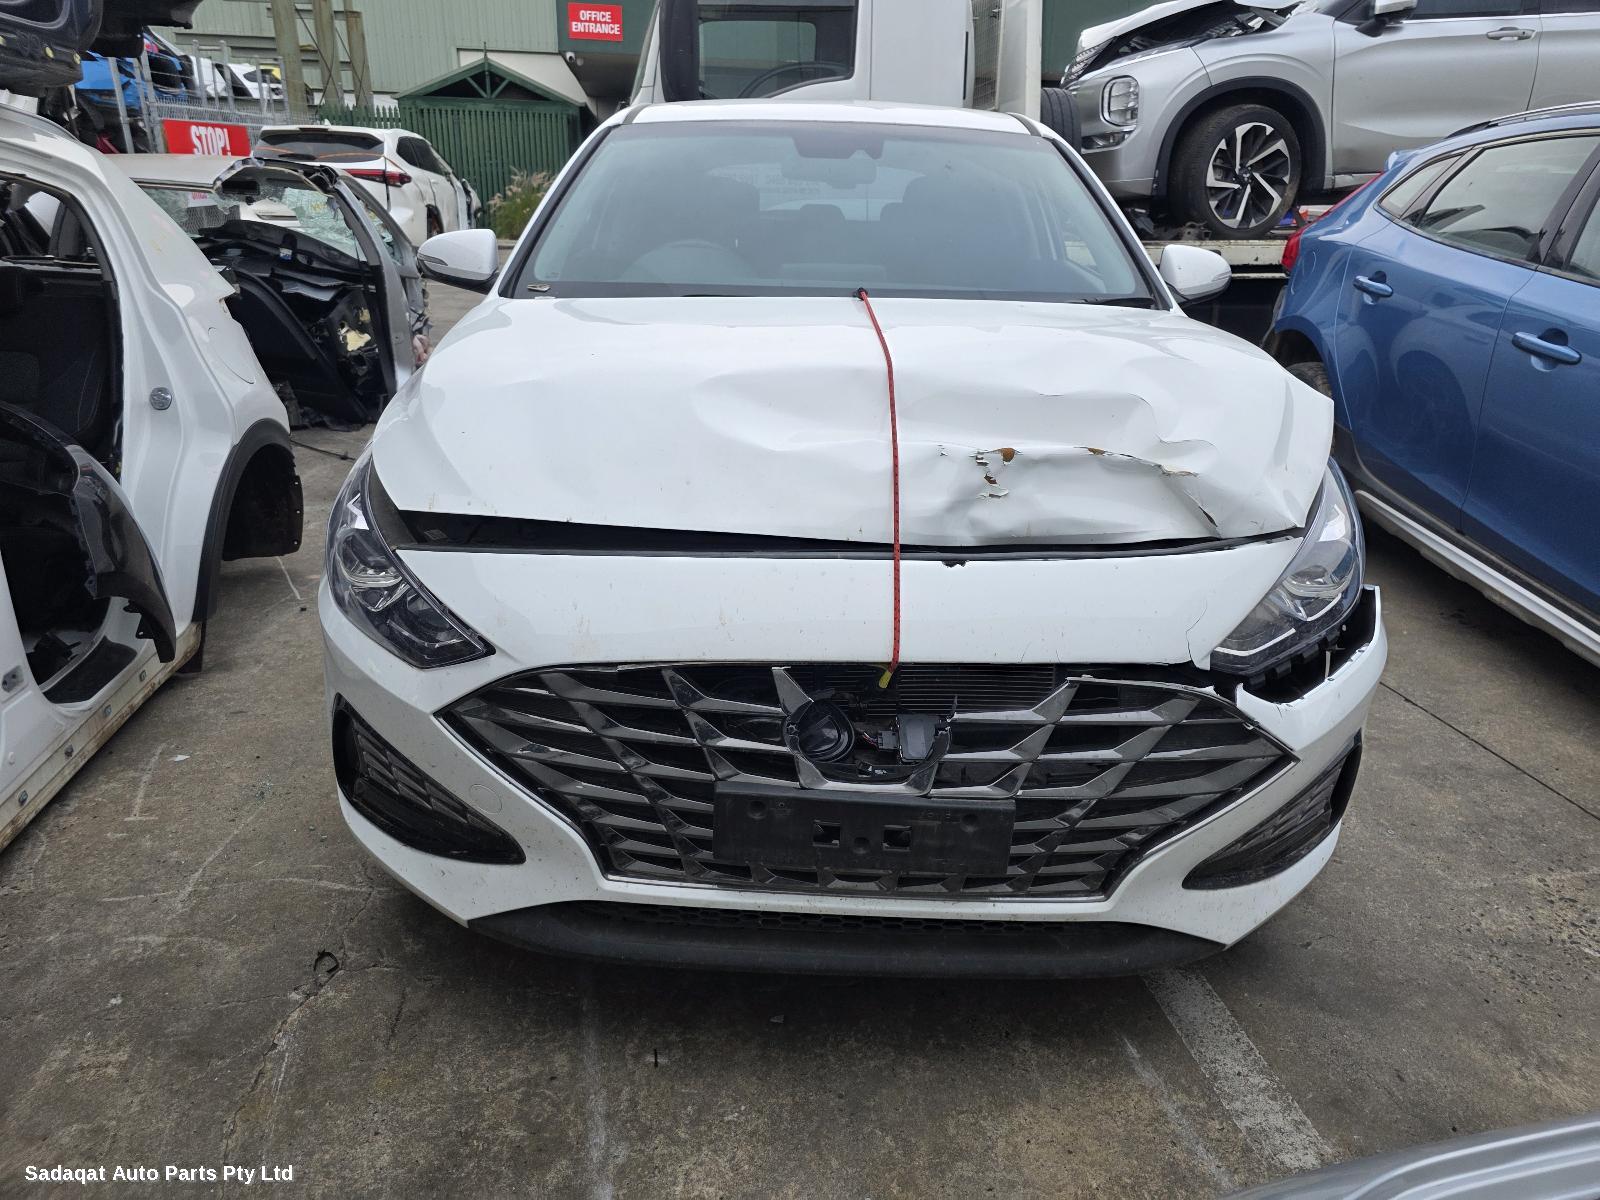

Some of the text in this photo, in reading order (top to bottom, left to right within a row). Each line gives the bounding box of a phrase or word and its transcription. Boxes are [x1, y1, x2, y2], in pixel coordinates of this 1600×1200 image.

[579, 10, 612, 22] OFFICE
[571, 21, 621, 35] ENTRANCE
[190, 125, 232, 156] STOP!
